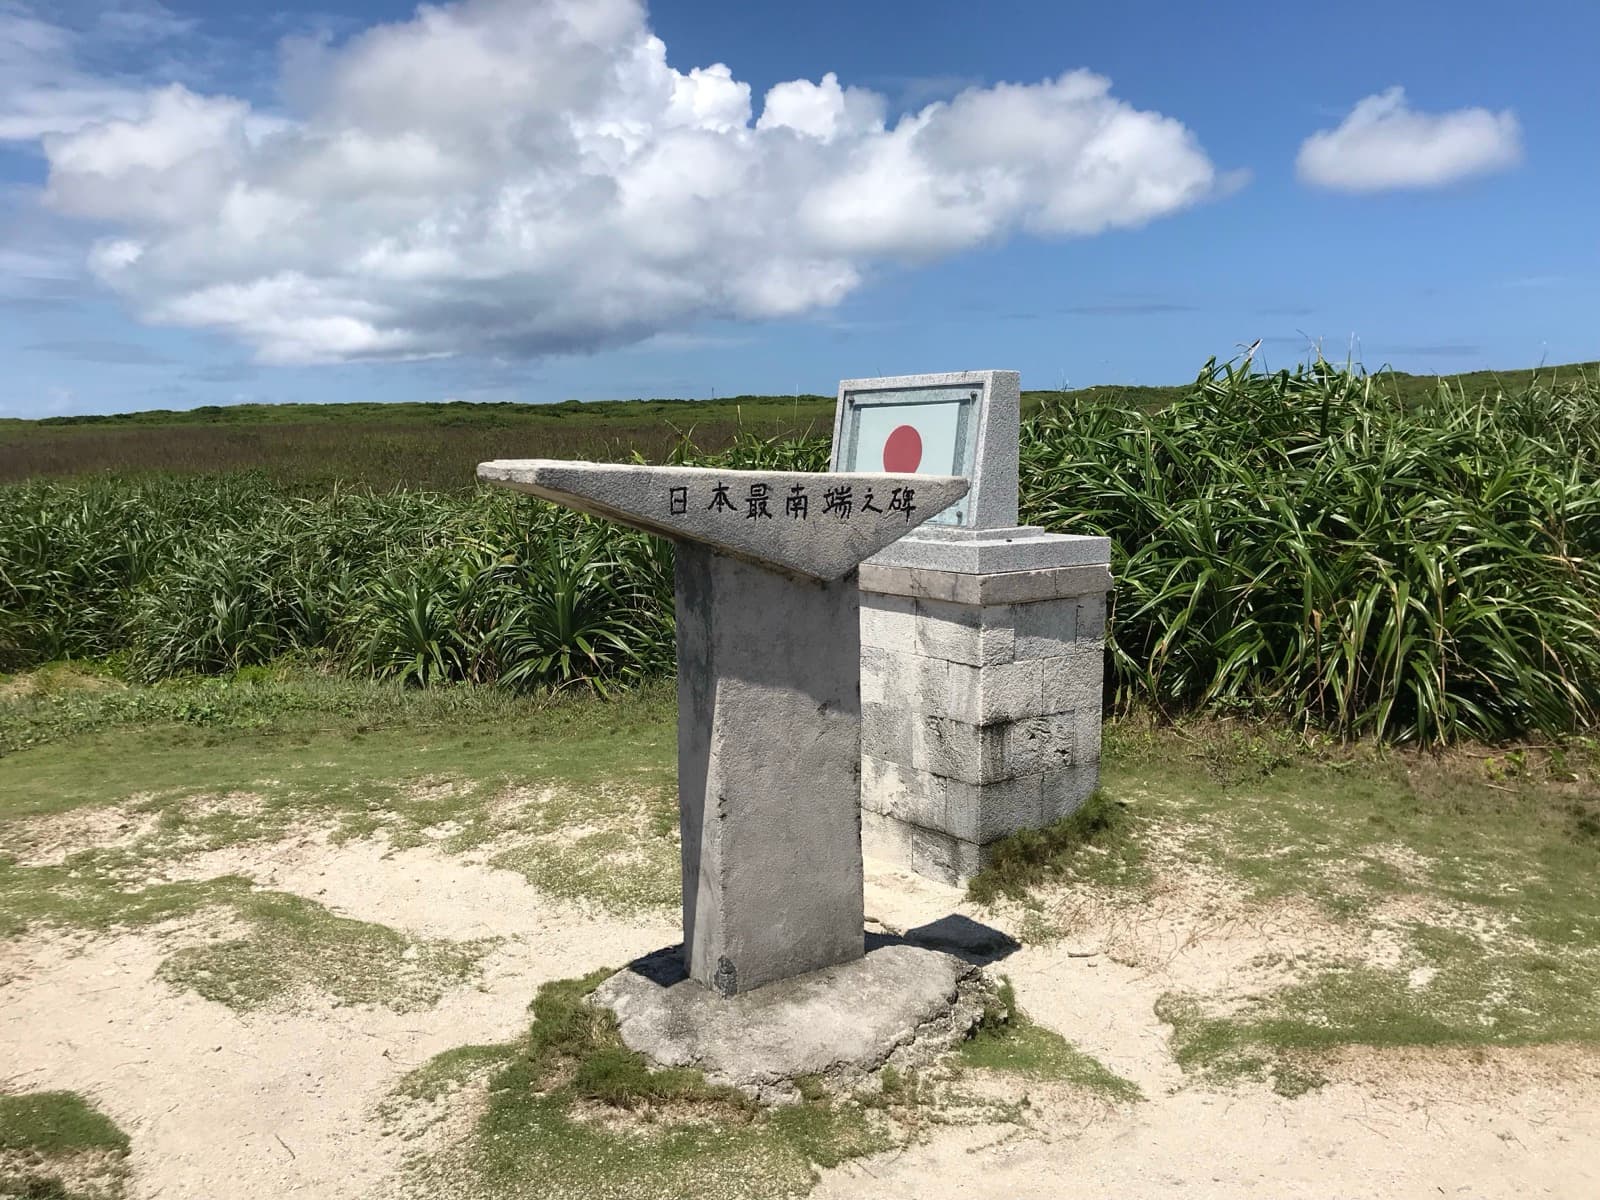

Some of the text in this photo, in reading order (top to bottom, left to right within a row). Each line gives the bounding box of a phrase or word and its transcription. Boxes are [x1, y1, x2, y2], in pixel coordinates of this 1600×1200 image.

[669, 481, 917, 522] 日本最南端之碑
